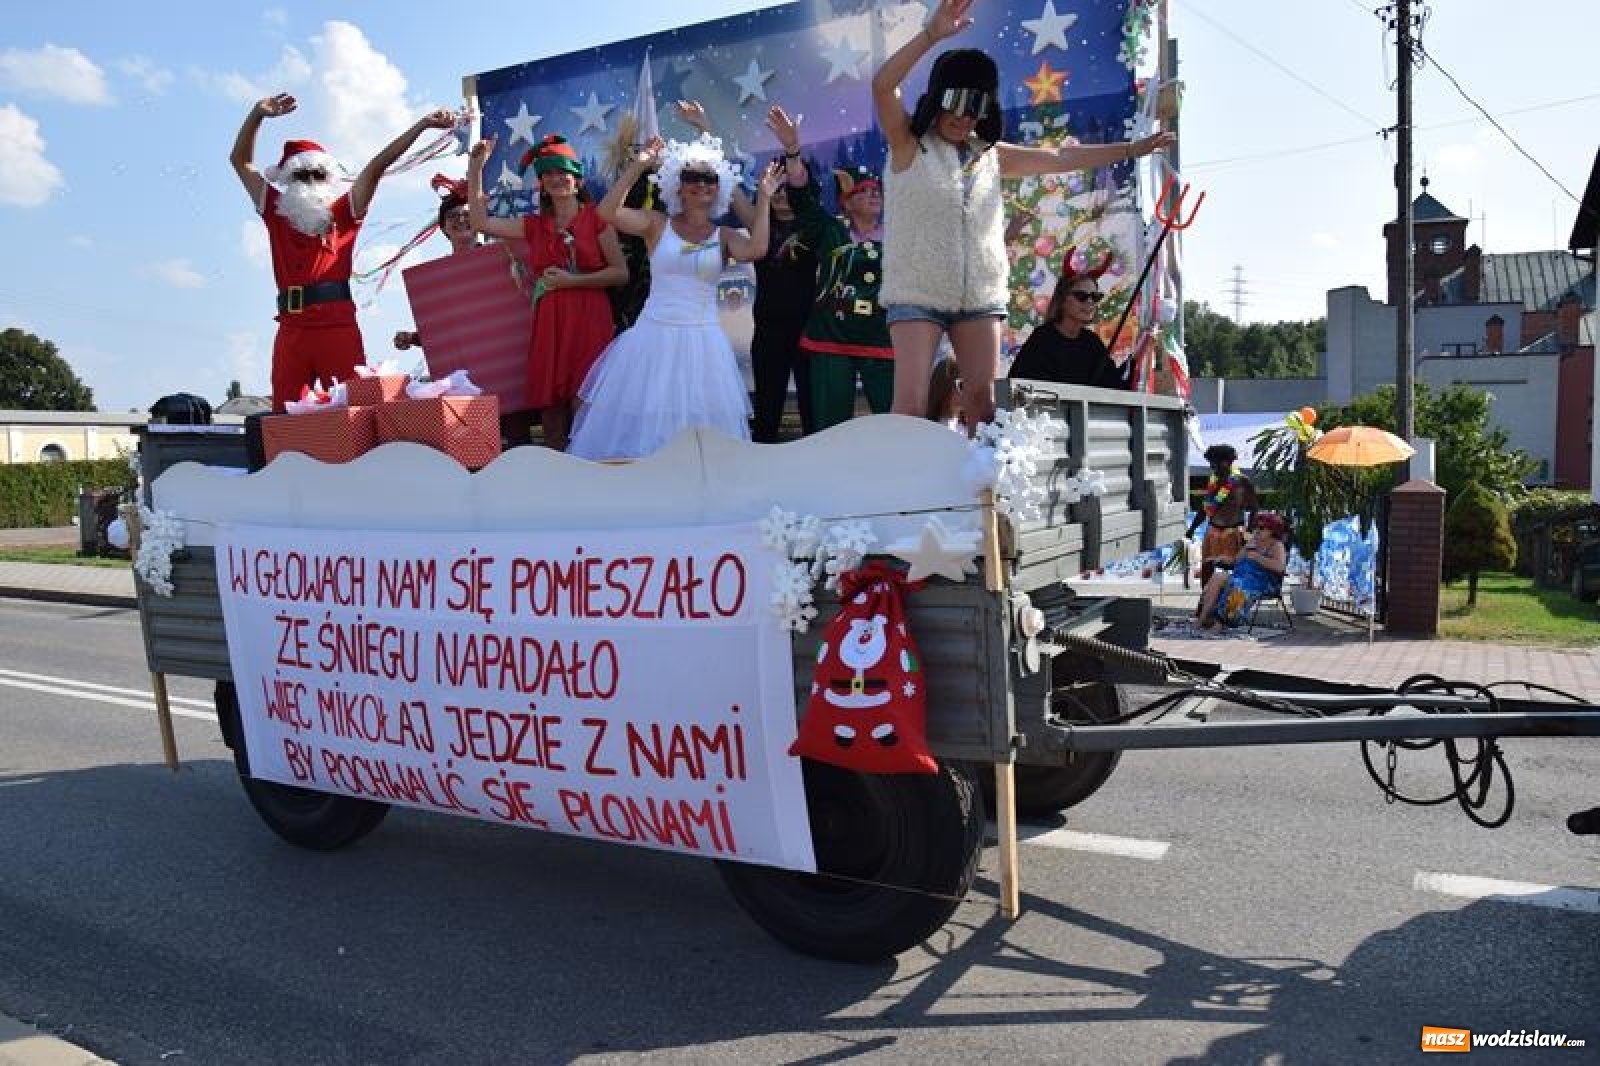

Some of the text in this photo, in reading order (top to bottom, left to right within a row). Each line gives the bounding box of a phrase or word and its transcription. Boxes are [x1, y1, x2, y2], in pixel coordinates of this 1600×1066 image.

[255, 549, 365, 606] GŁOWACH
[377, 558, 436, 611] NAM
[275, 609, 312, 669] ŻE
[435, 631, 619, 699] NAPADAŁO
[283, 737, 316, 784] BY
[582, 717, 617, 776] Z
